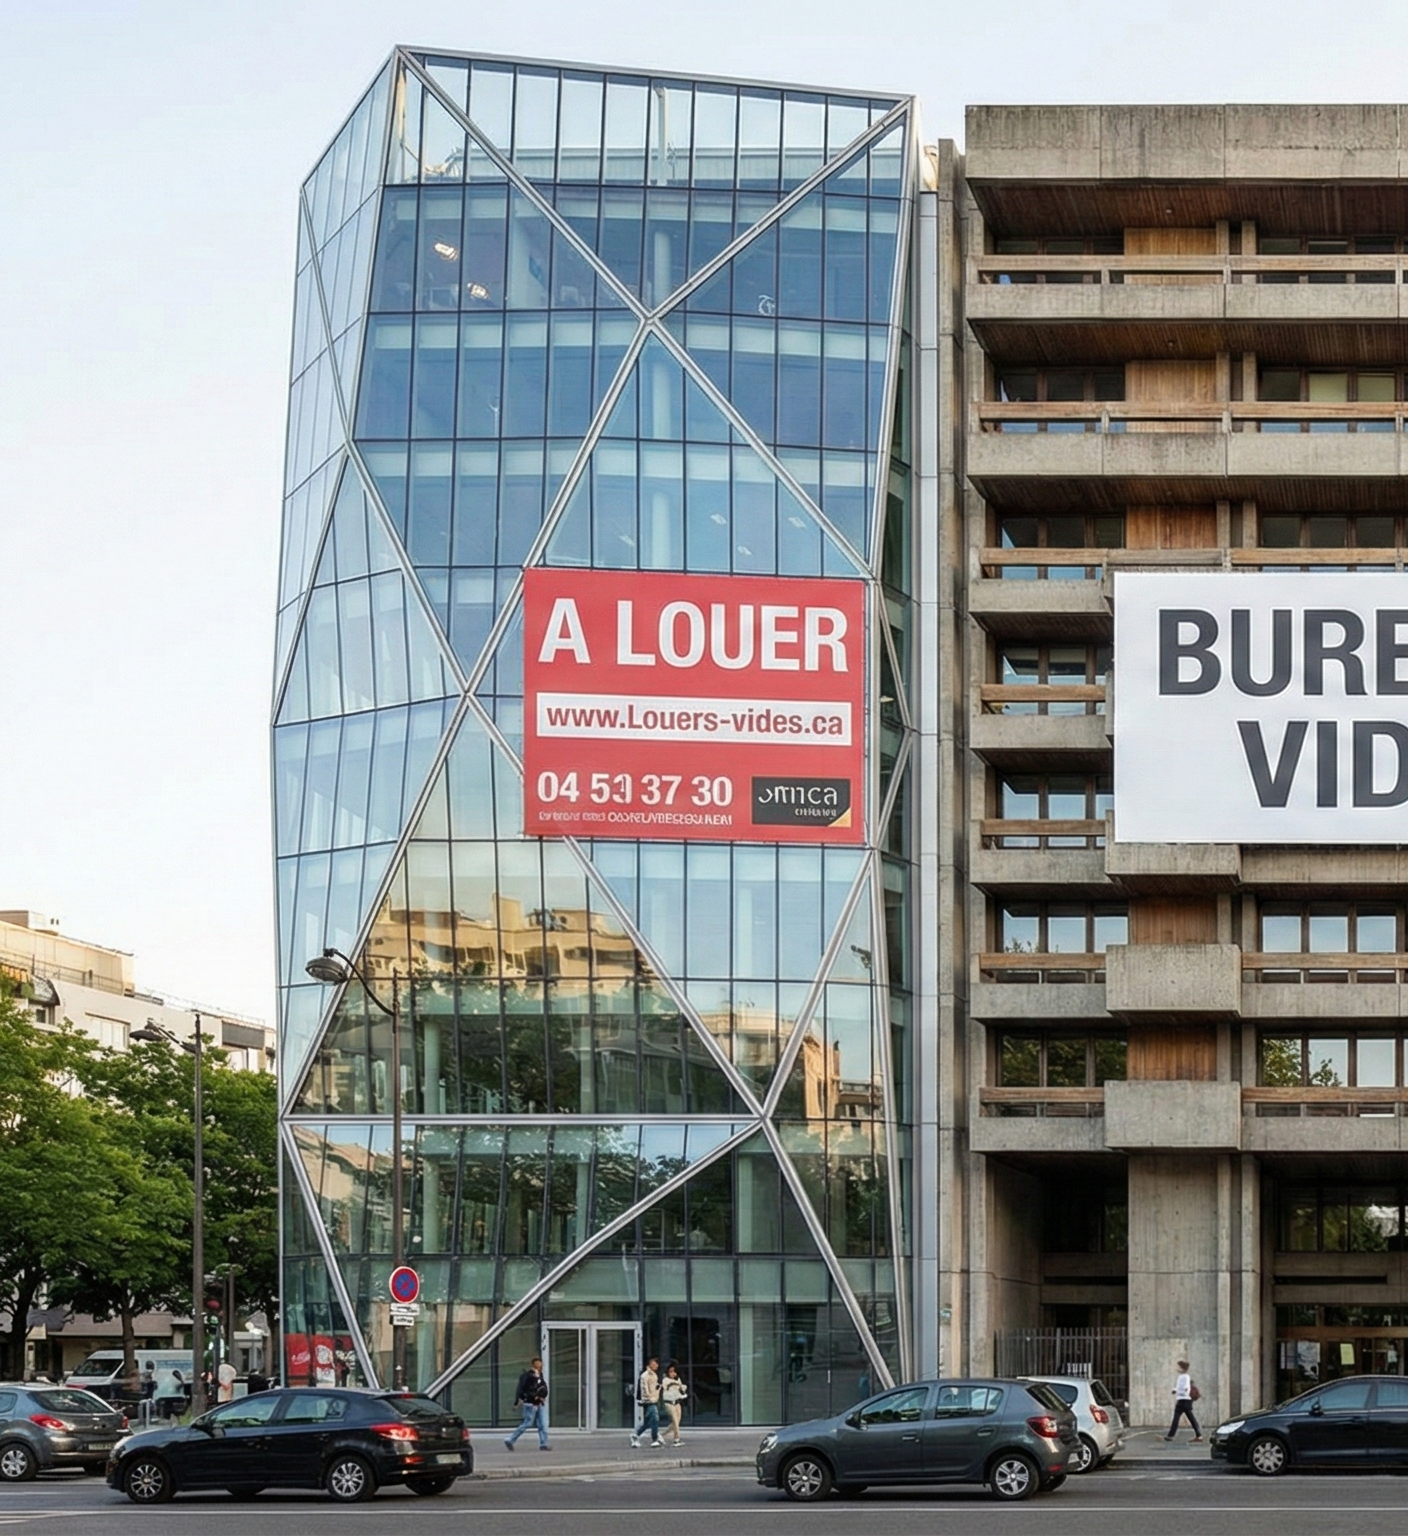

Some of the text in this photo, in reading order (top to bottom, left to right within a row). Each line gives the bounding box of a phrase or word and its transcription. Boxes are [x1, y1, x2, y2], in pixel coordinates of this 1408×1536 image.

[538, 597, 849, 672] A LOUER
[547, 704, 844, 736] www.Louers-vides.ca
[537, 771, 580, 803] 04
[641, 774, 682, 805] 37
[691, 776, 733, 807] 30
